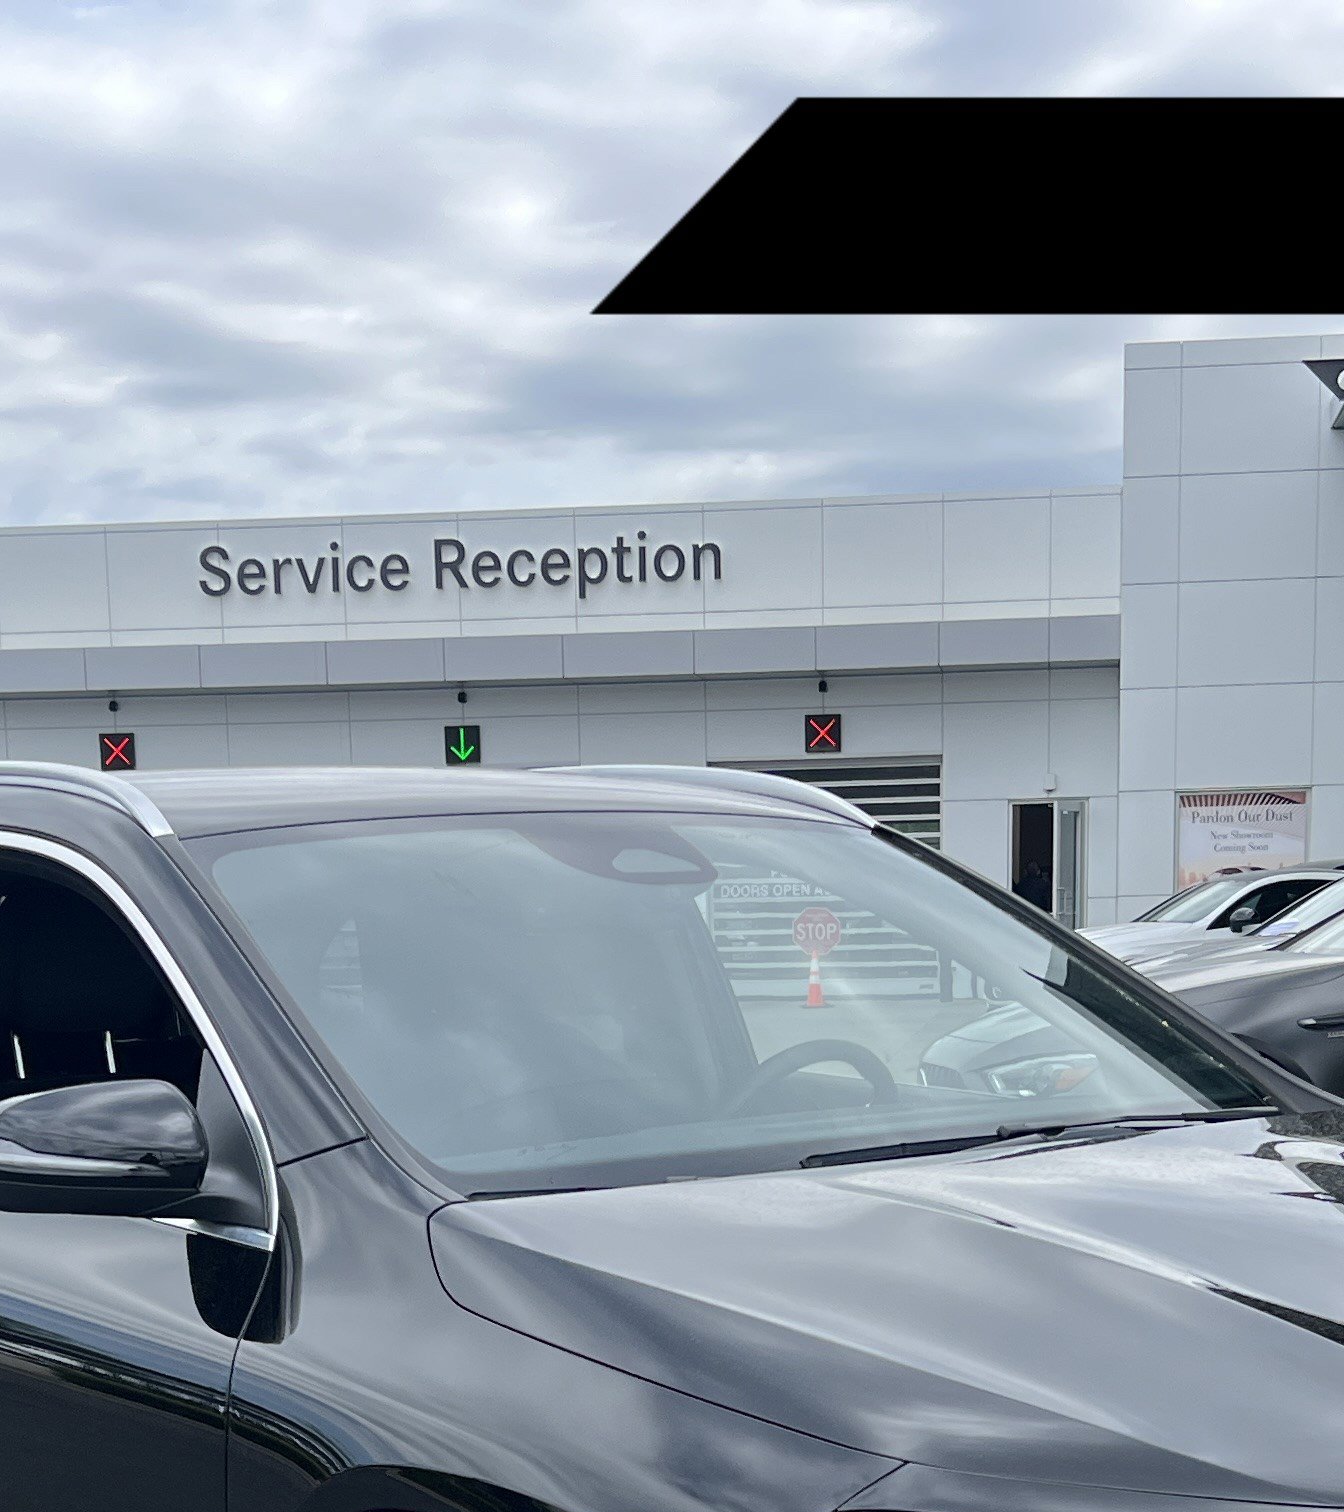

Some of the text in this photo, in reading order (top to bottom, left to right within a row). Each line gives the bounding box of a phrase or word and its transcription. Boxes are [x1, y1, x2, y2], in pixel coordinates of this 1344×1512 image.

[198, 530, 722, 600] Service Reception
[1191, 808, 1294, 824] Pardon Our Dust
[720, 884, 769, 898] DOORS
[772, 883, 811, 897] OPEN
[795, 922, 837, 941] STOP
